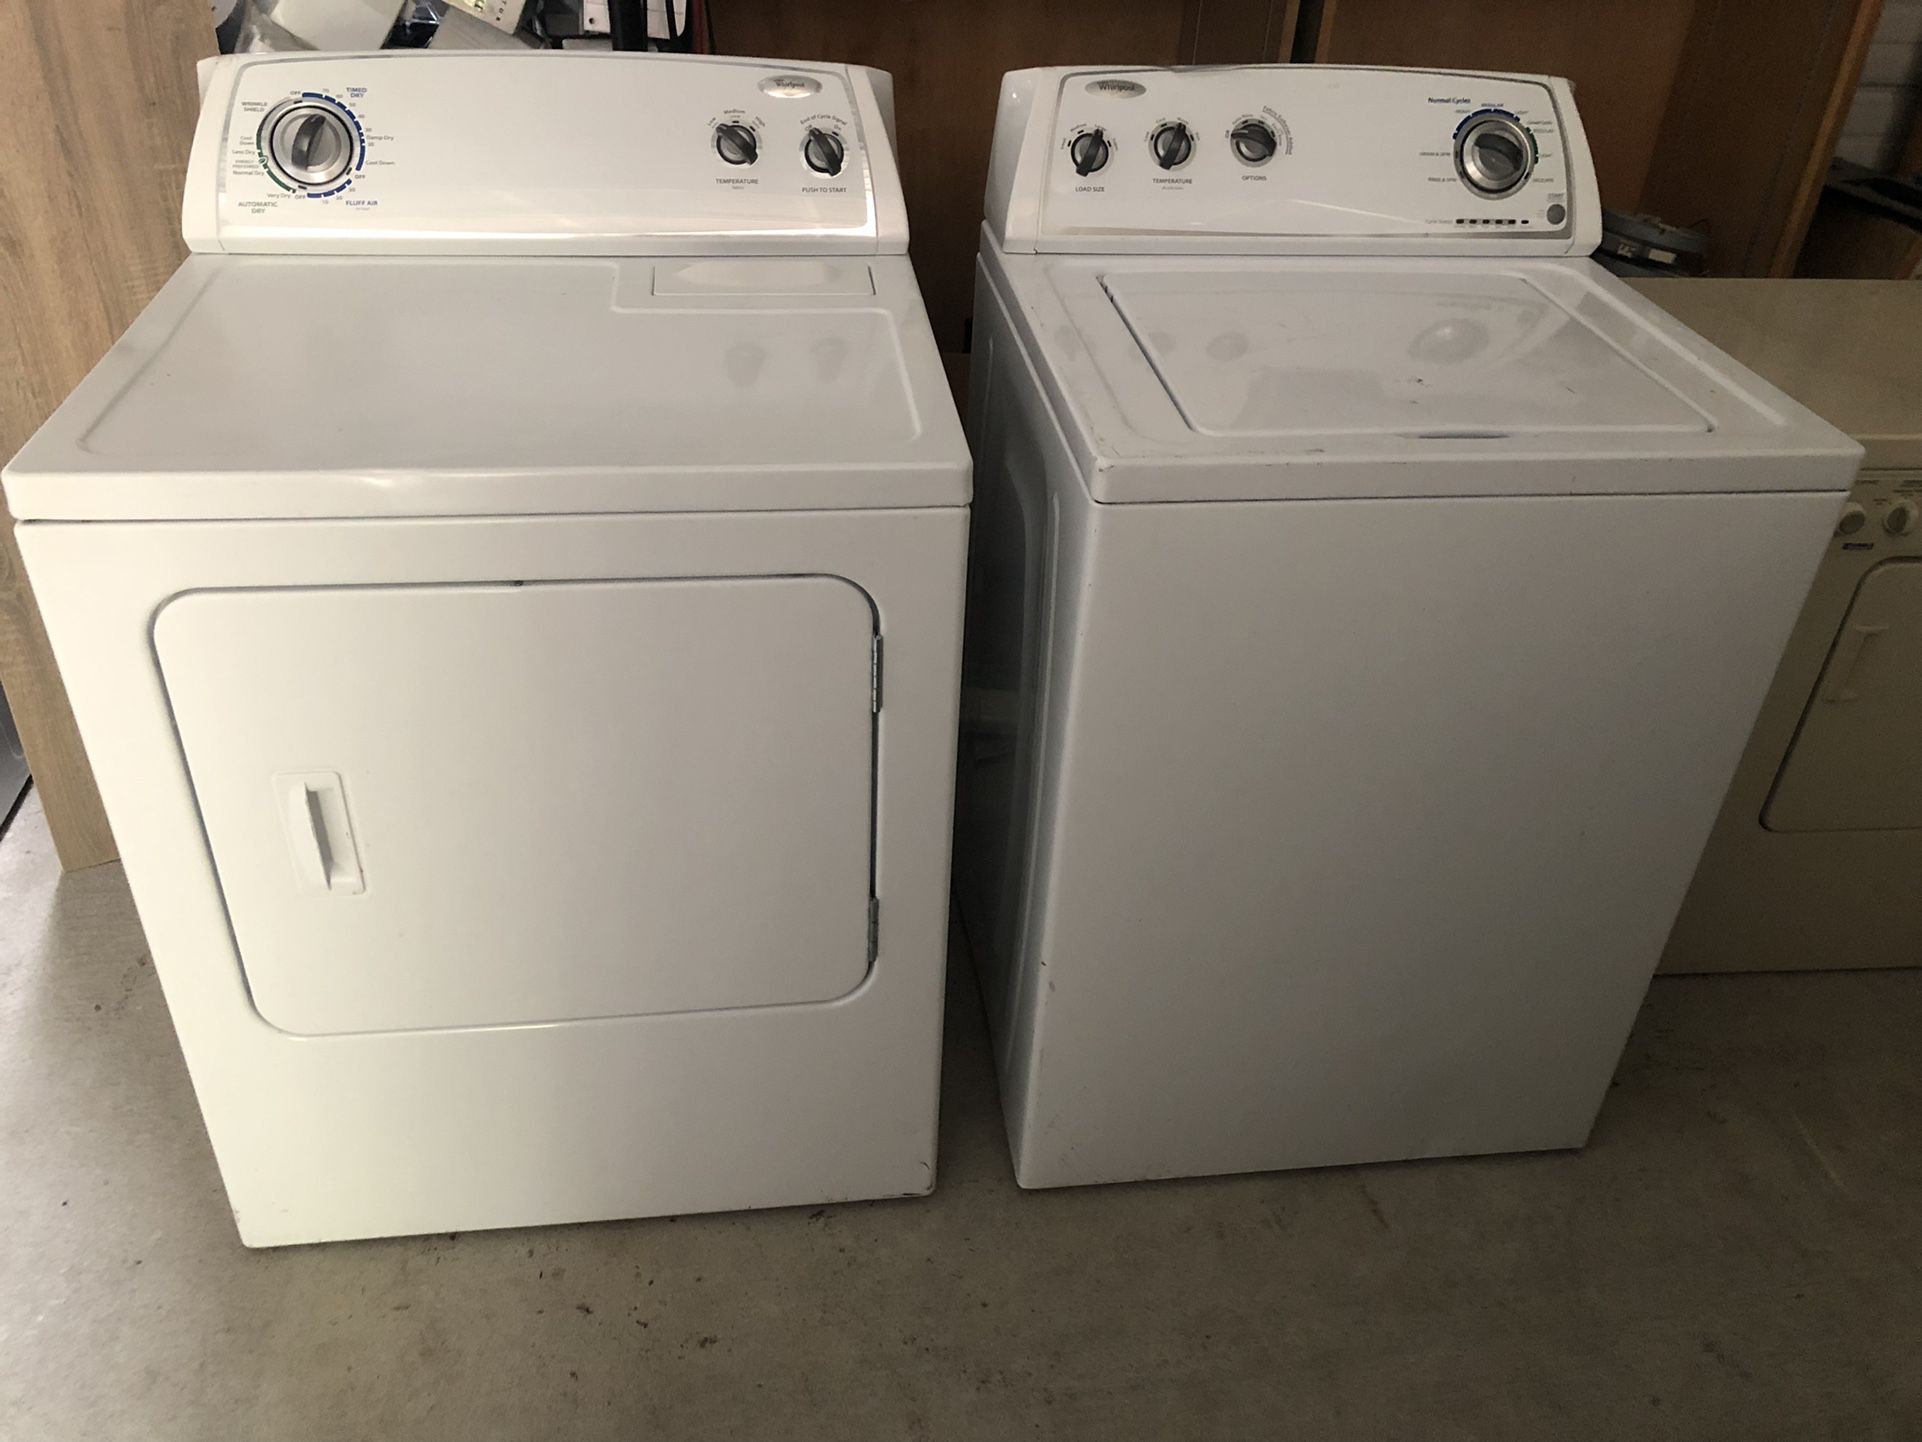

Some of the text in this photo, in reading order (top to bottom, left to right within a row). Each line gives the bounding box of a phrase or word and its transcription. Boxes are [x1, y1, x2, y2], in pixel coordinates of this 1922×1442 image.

[774, 80, 805, 89] Whirlpool
[1098, 81, 1136, 92] Whirlpool
[1452, 97, 1471, 105] Cycles
